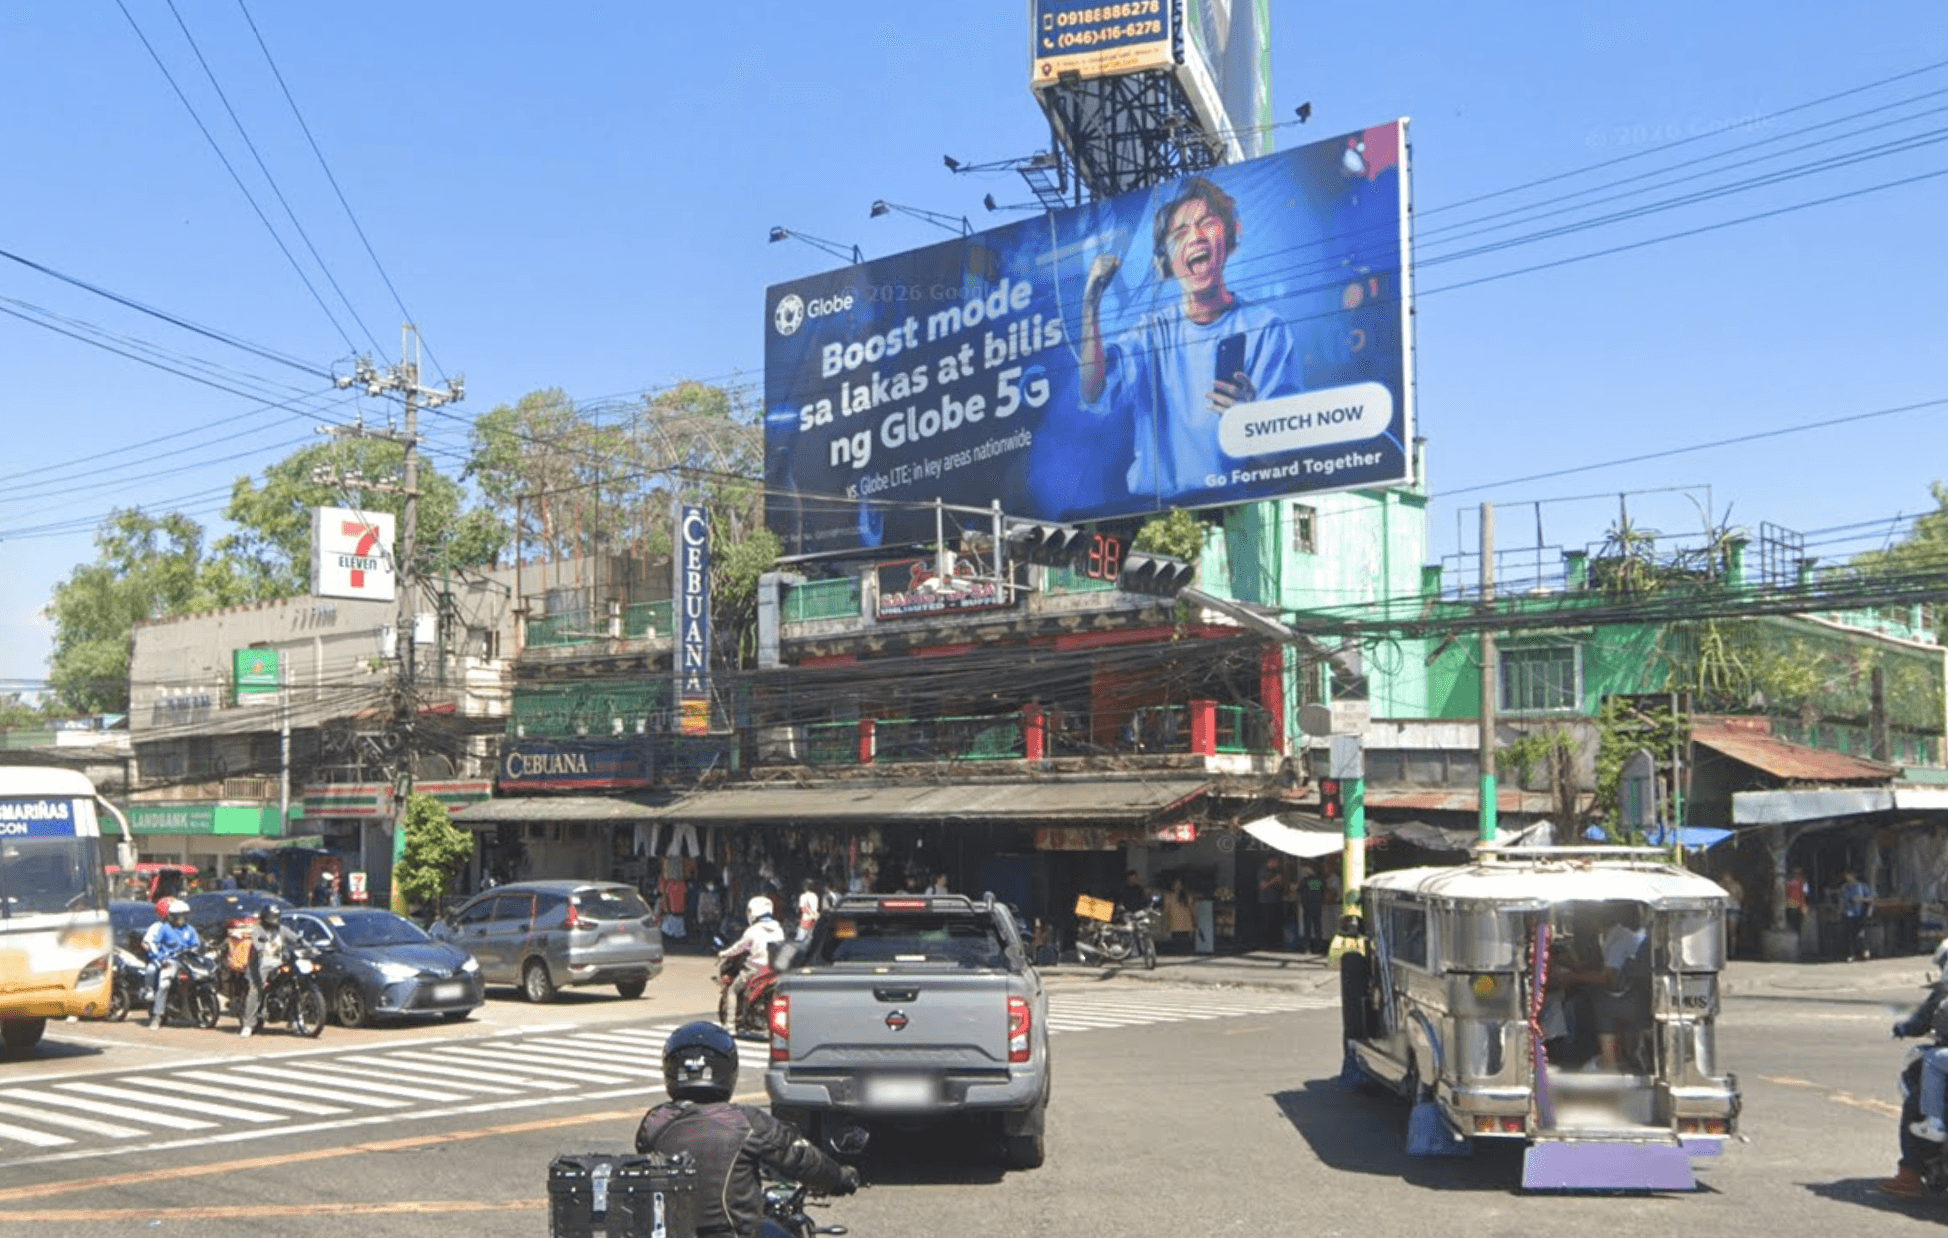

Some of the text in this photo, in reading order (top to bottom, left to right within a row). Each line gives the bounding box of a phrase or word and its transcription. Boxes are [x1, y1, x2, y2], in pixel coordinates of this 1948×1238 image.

[807, 295, 854, 318] Globe
[822, 277, 1033, 379] Boost mode
[799, 313, 1063, 432] sa lakas at bilis
[830, 365, 1051, 469] ng Globe 5G
[1244, 405, 1364, 438] SWITCH NOW
[860, 472, 889, 495] Globe
[913, 461, 923, 480] in
[925, 457, 942, 479] key
[943, 449, 972, 471] areas
[973, 427, 1032, 462] nationwide
[1205, 451, 1383, 487] Go Forward Together
[341, 521, 379, 588] 7
[683, 512, 705, 691] CEBUANA
[506, 751, 588, 779] CEBUANA
